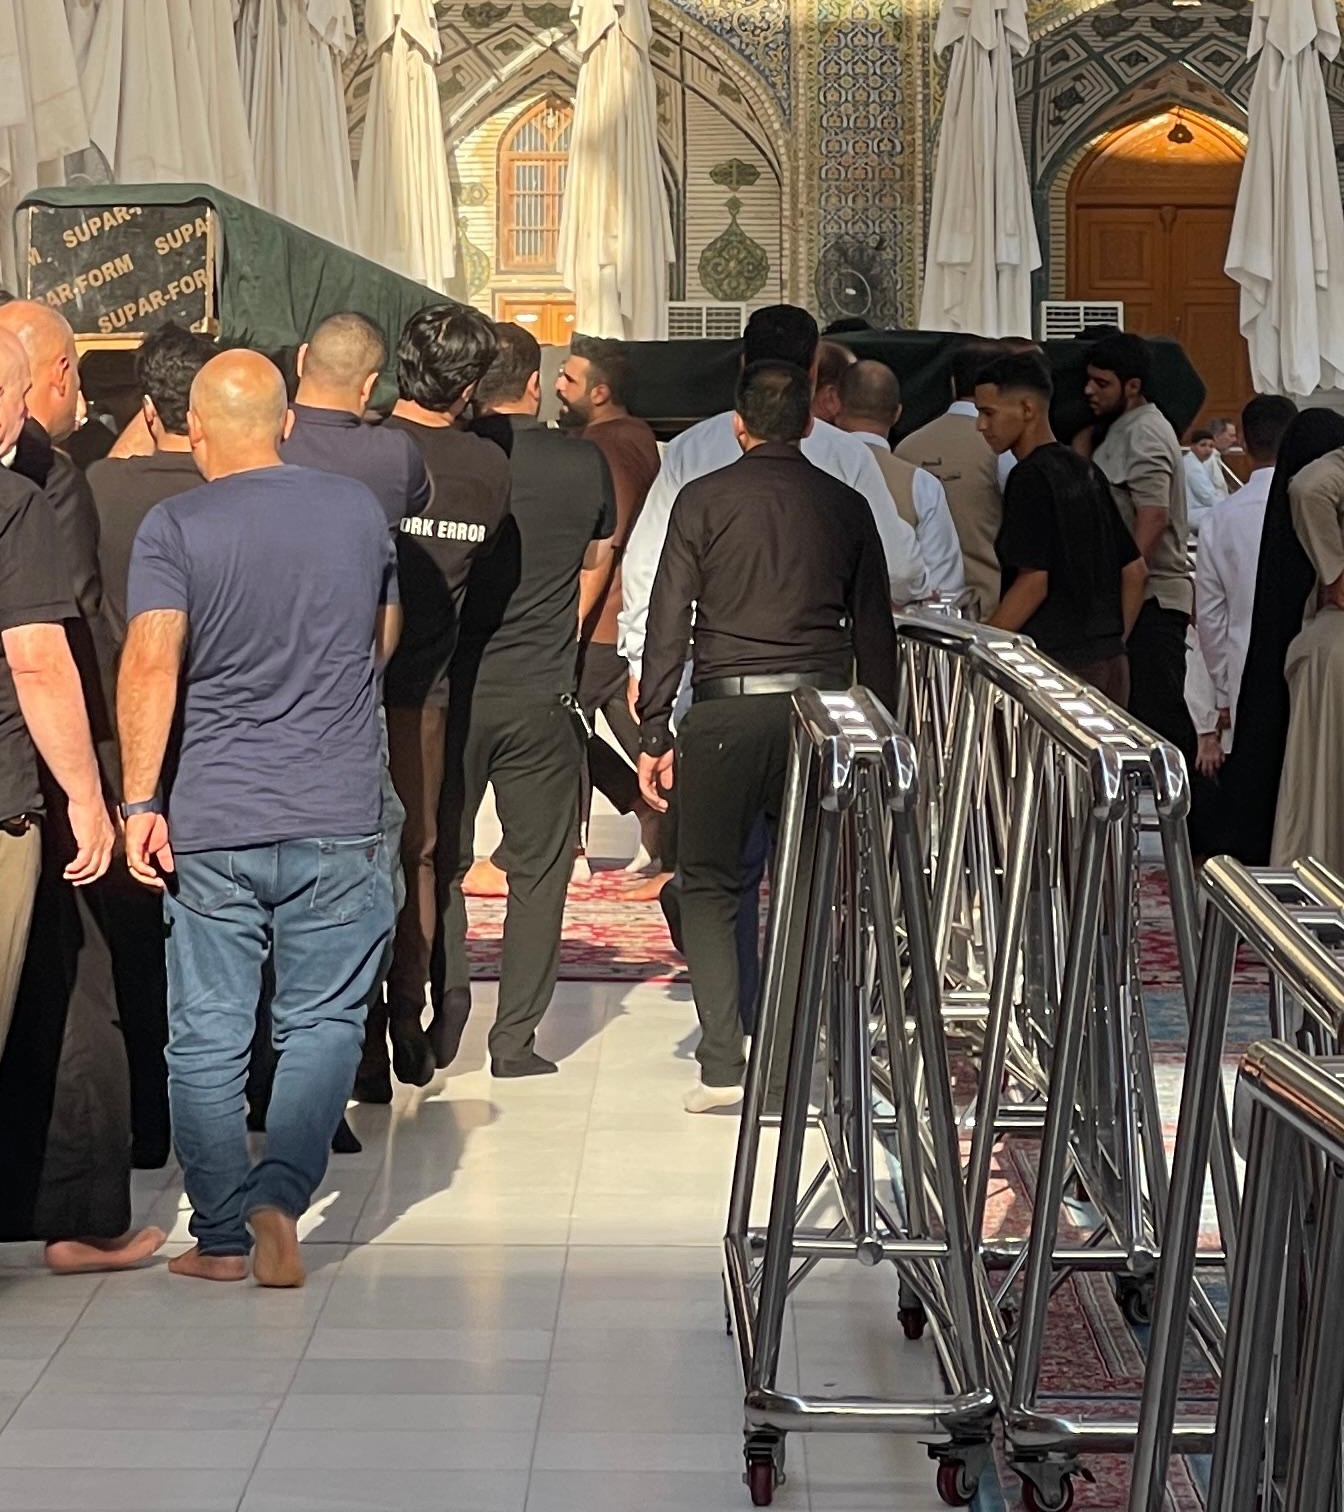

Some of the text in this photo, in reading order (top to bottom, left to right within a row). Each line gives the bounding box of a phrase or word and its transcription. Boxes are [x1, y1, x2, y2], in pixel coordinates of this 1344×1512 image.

[154, 216, 208, 256] SUPA
[400, 517, 486, 542] ORK ERROR
